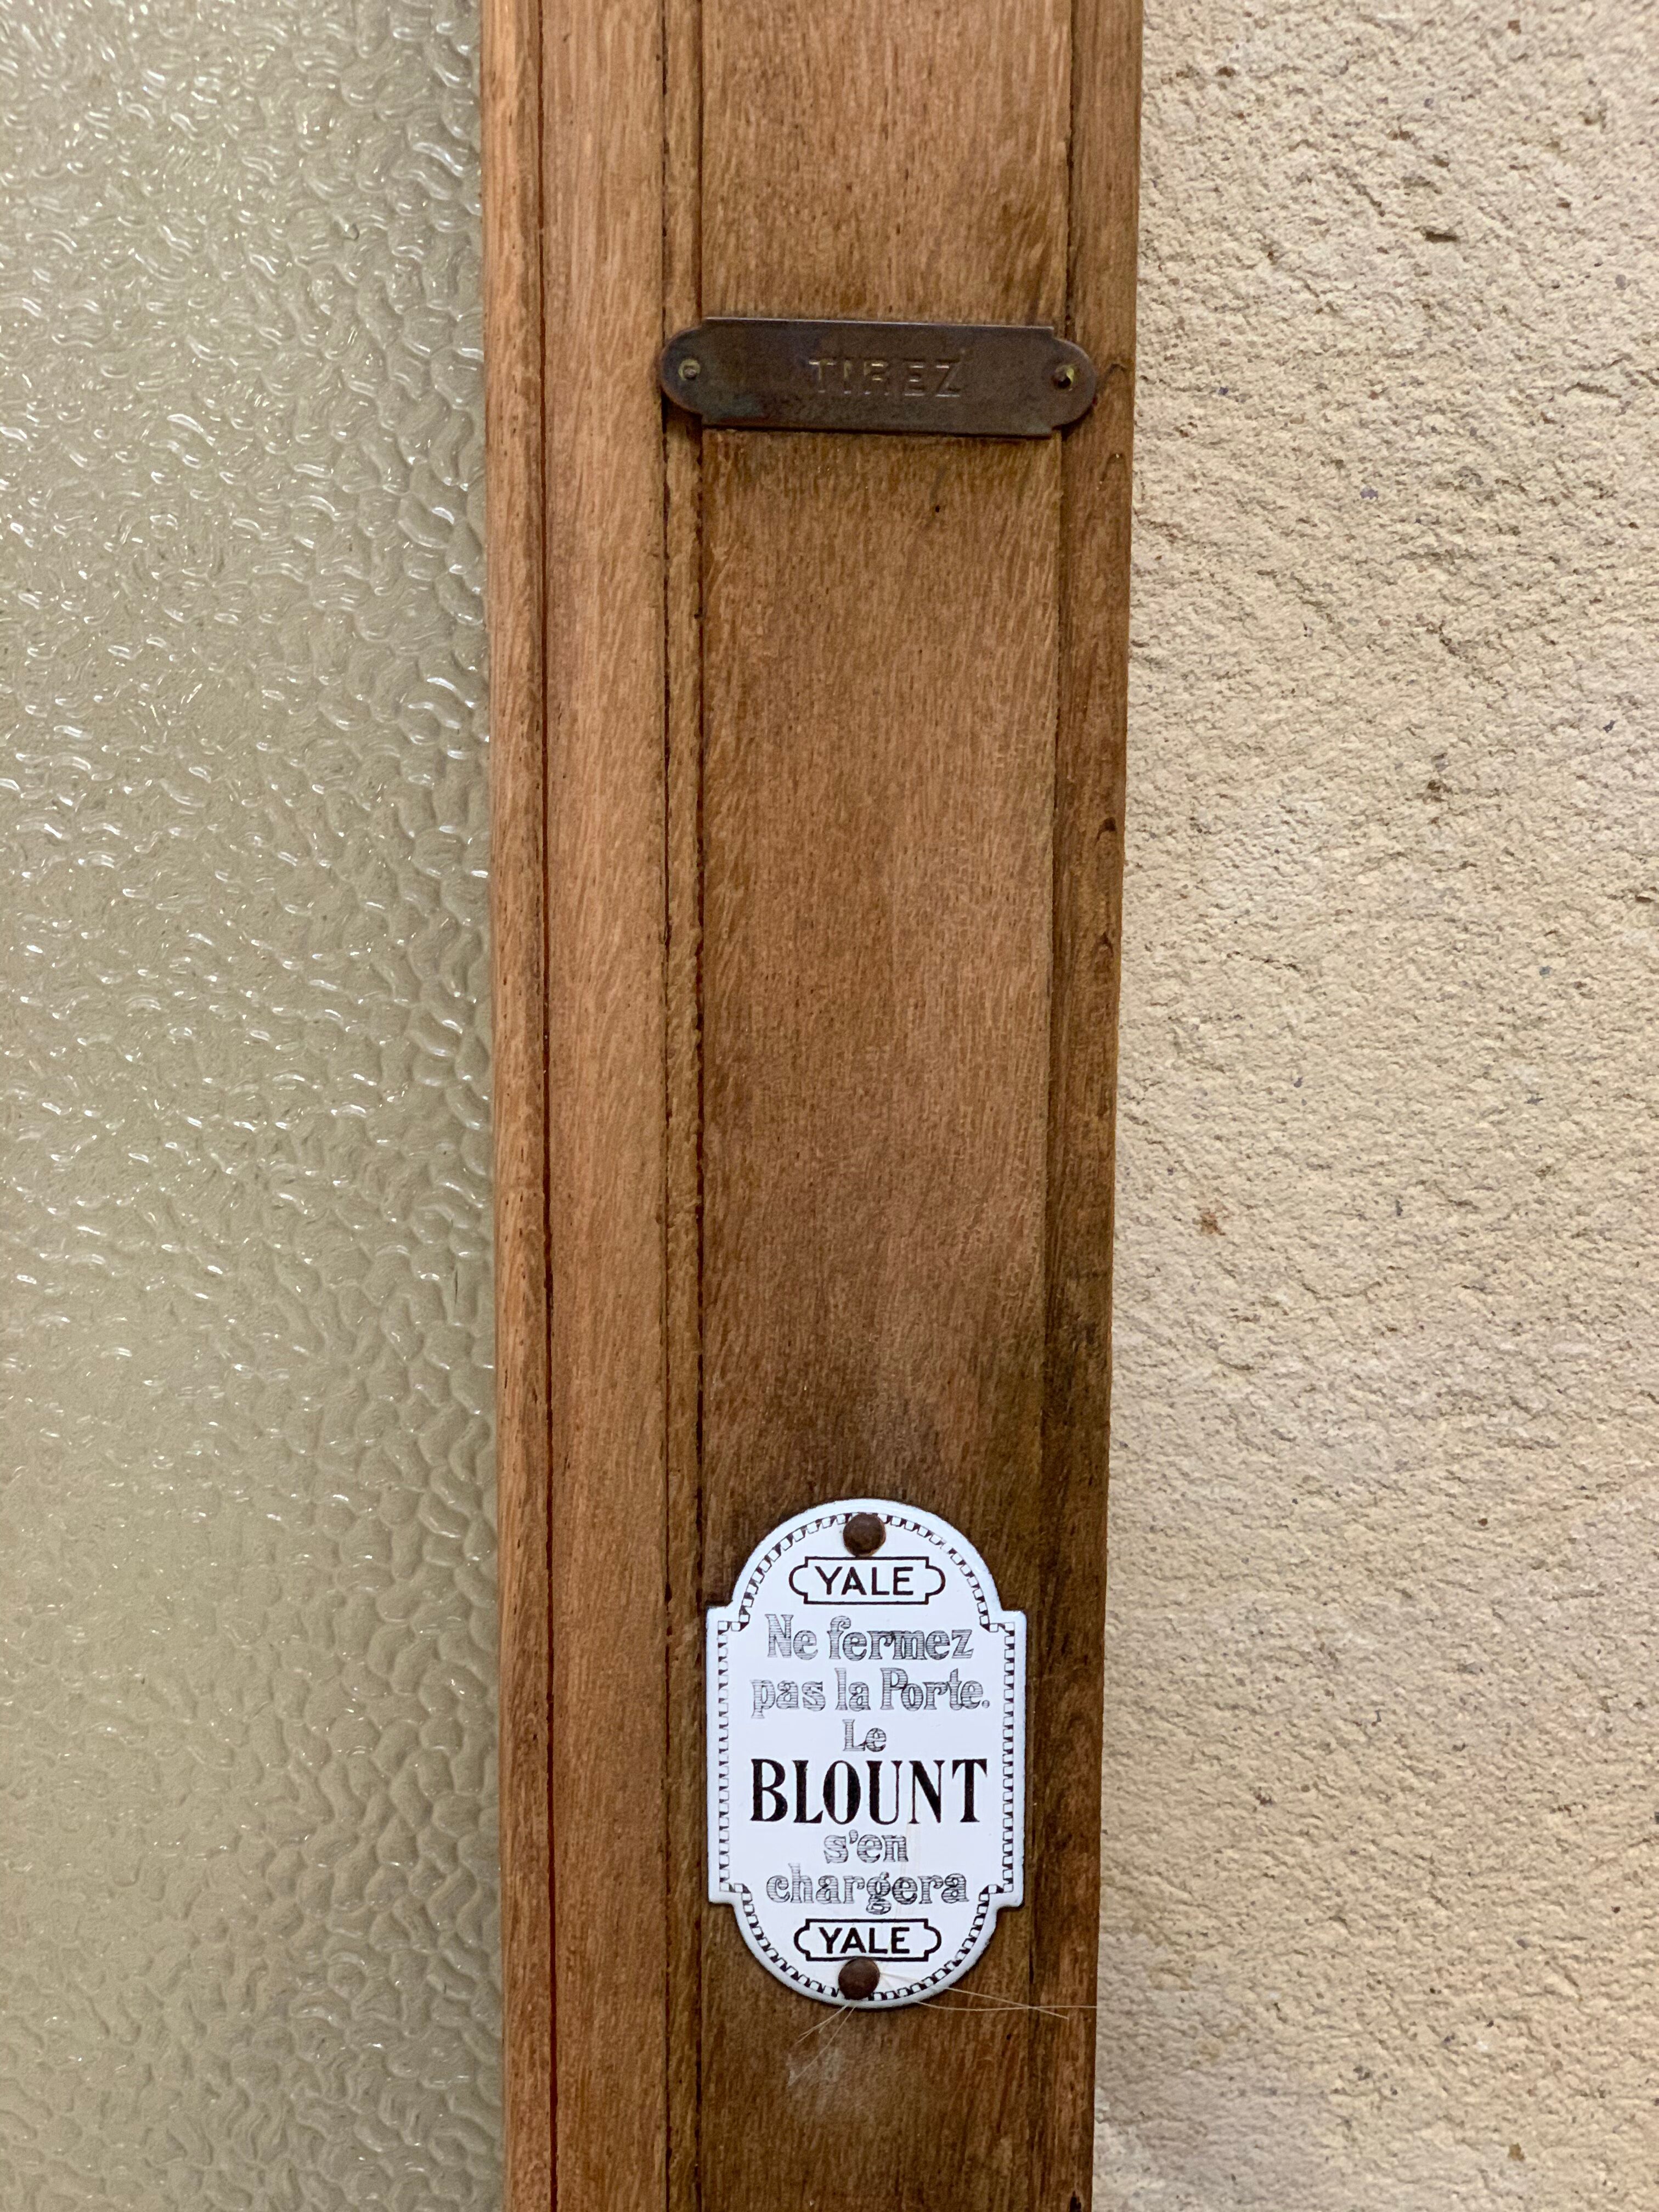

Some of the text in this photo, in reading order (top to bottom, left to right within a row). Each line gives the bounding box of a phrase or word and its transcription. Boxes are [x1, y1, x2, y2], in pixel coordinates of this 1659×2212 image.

[808, 356, 964, 398] TIREZ
[815, 1565, 915, 1595] YALE
[765, 1613, 974, 1661] Ne fermez
[750, 1667, 990, 1719] pas la Porte.
[842, 1718, 887, 1752] Le
[749, 1758, 988, 1825] BLOUNT
[823, 1830, 909, 1864] s'en
[766, 1863, 970, 1915] chargera
[819, 1927, 910, 1955] YALE
